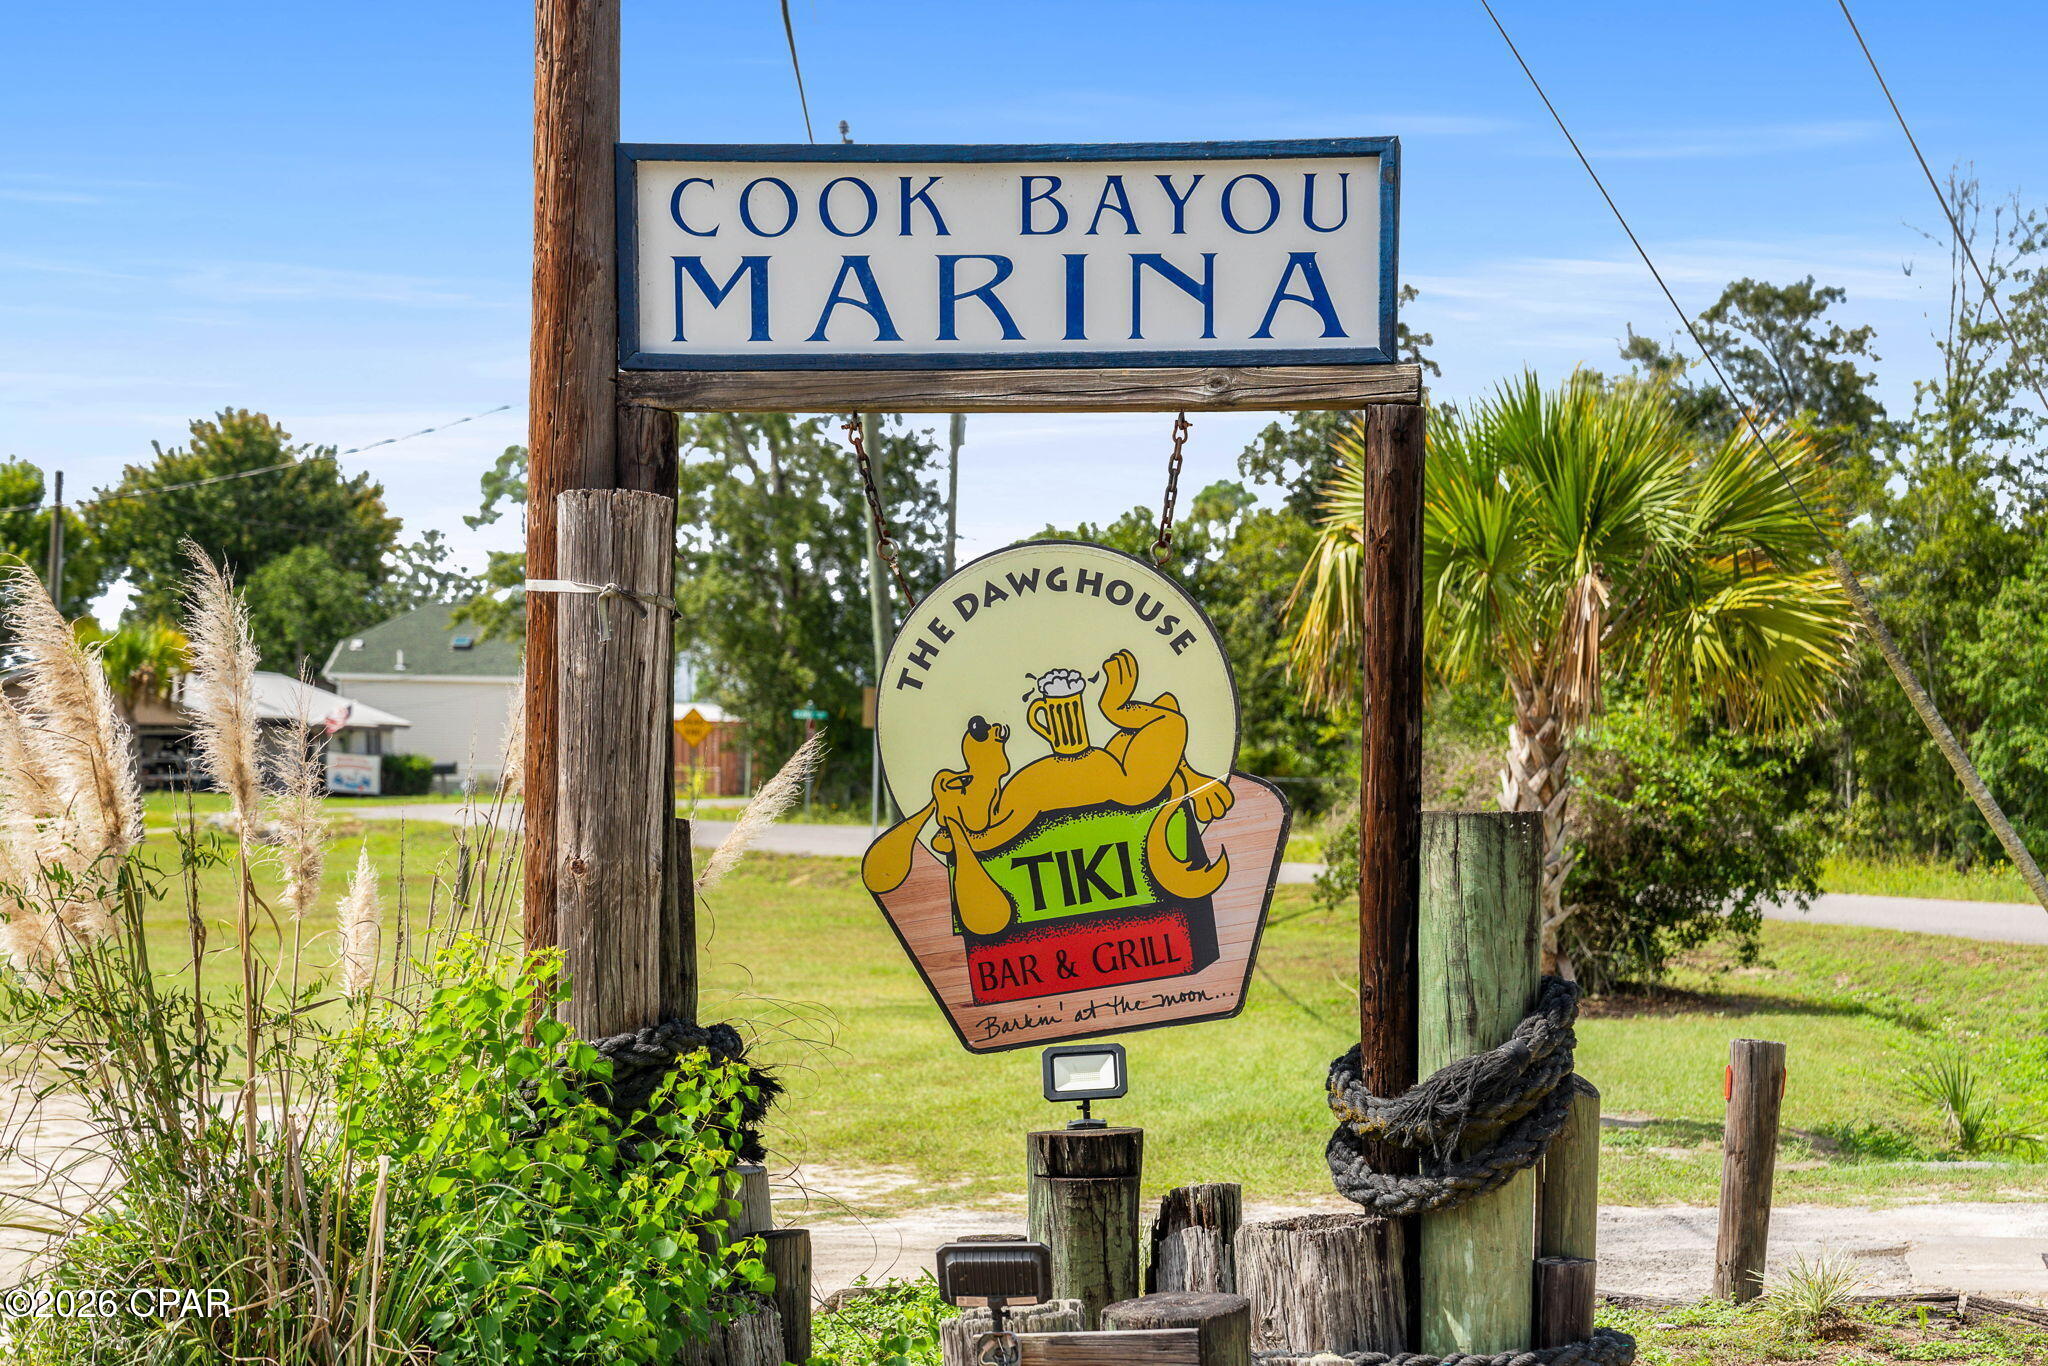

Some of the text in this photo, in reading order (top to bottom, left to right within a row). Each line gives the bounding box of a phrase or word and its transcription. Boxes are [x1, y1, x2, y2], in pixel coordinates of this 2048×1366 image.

[670, 173, 1350, 238] COOK BAYOU
[670, 251, 1350, 342] MARINA
[896, 566, 1197, 691] THE DAWGHOUSE
[1010, 841, 1138, 911] TIKI
[977, 933, 1181, 991] BAR & GRILL
[974, 1001, 1063, 1042] Barkin'
[1074, 1000, 1106, 1023] at
[1103, 995, 1143, 1015] the
